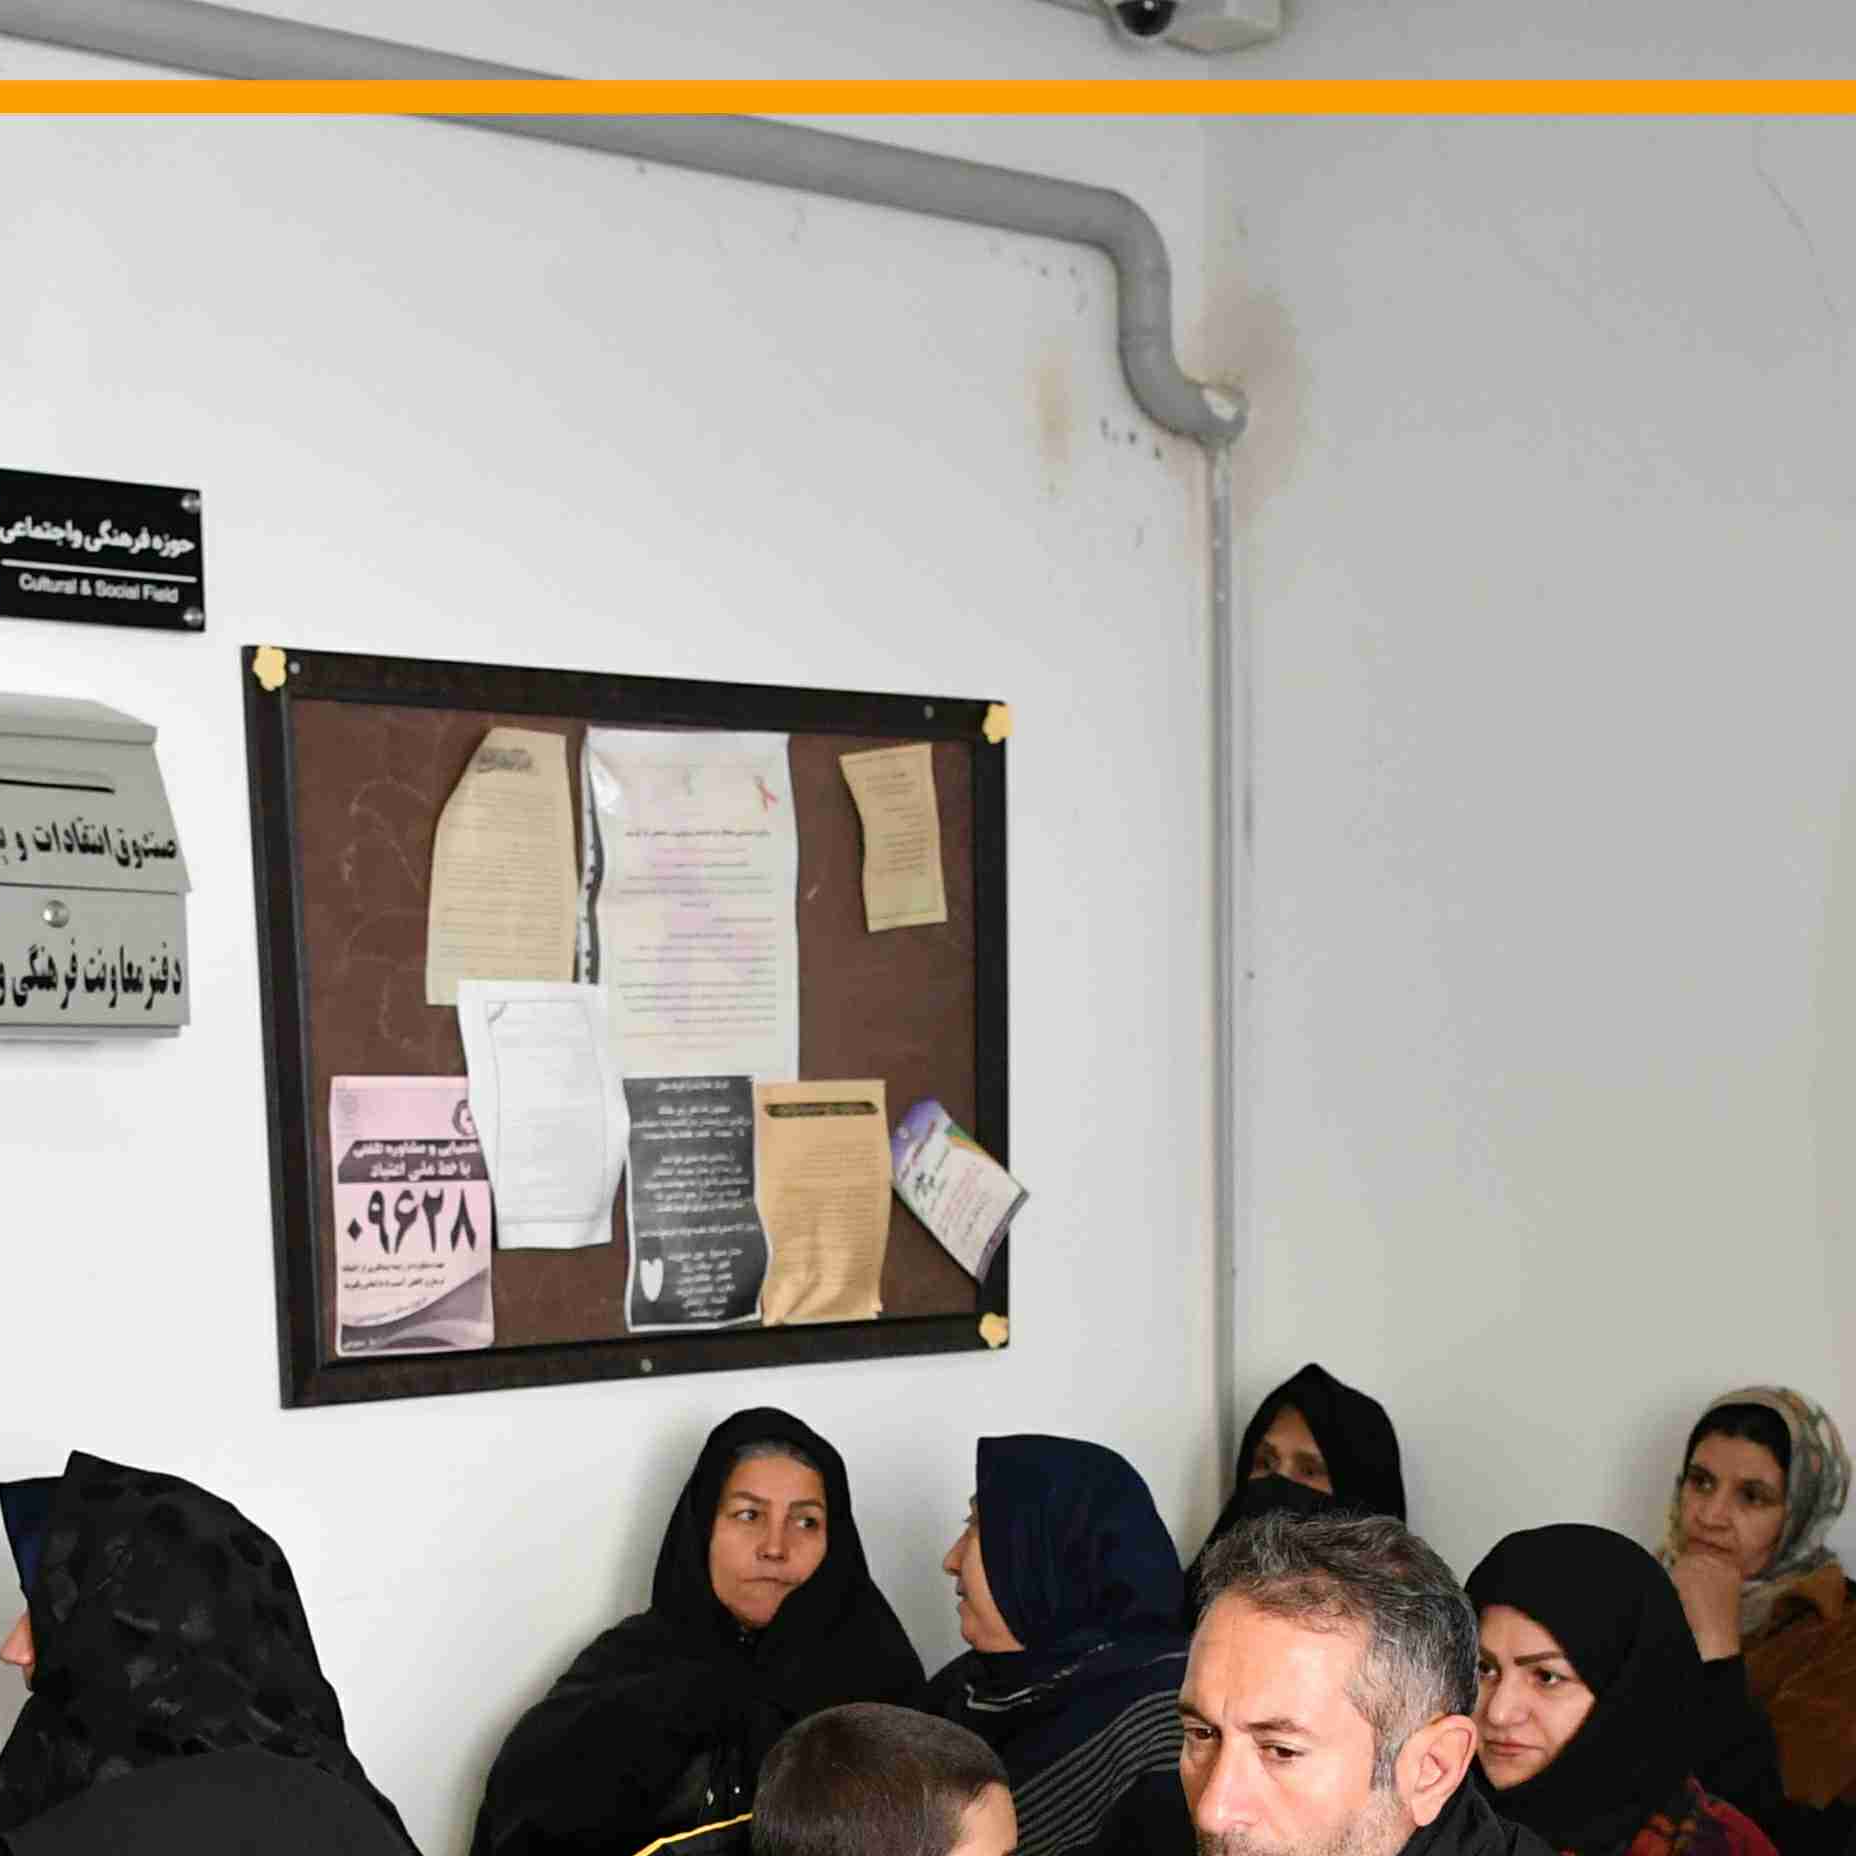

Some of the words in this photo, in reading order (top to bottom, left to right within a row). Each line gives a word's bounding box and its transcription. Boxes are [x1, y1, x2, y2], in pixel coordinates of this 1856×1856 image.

[84, 518, 151, 555] فرهنگی
[151, 533, 196, 559] حوزه
[17, 571, 78, 596] Cultural
[80, 578, 92, 597] &
[94, 579, 140, 601] Social
[142, 583, 180, 605] Field
[14, 830, 29, 863] و
[32, 815, 113, 857] انتقادات
[114, 827, 178, 870] صندوق
[11, 938, 79, 1011] فرهنگی
[82, 945, 145, 1009] معاونت
[144, 941, 184, 1011] دفتر
